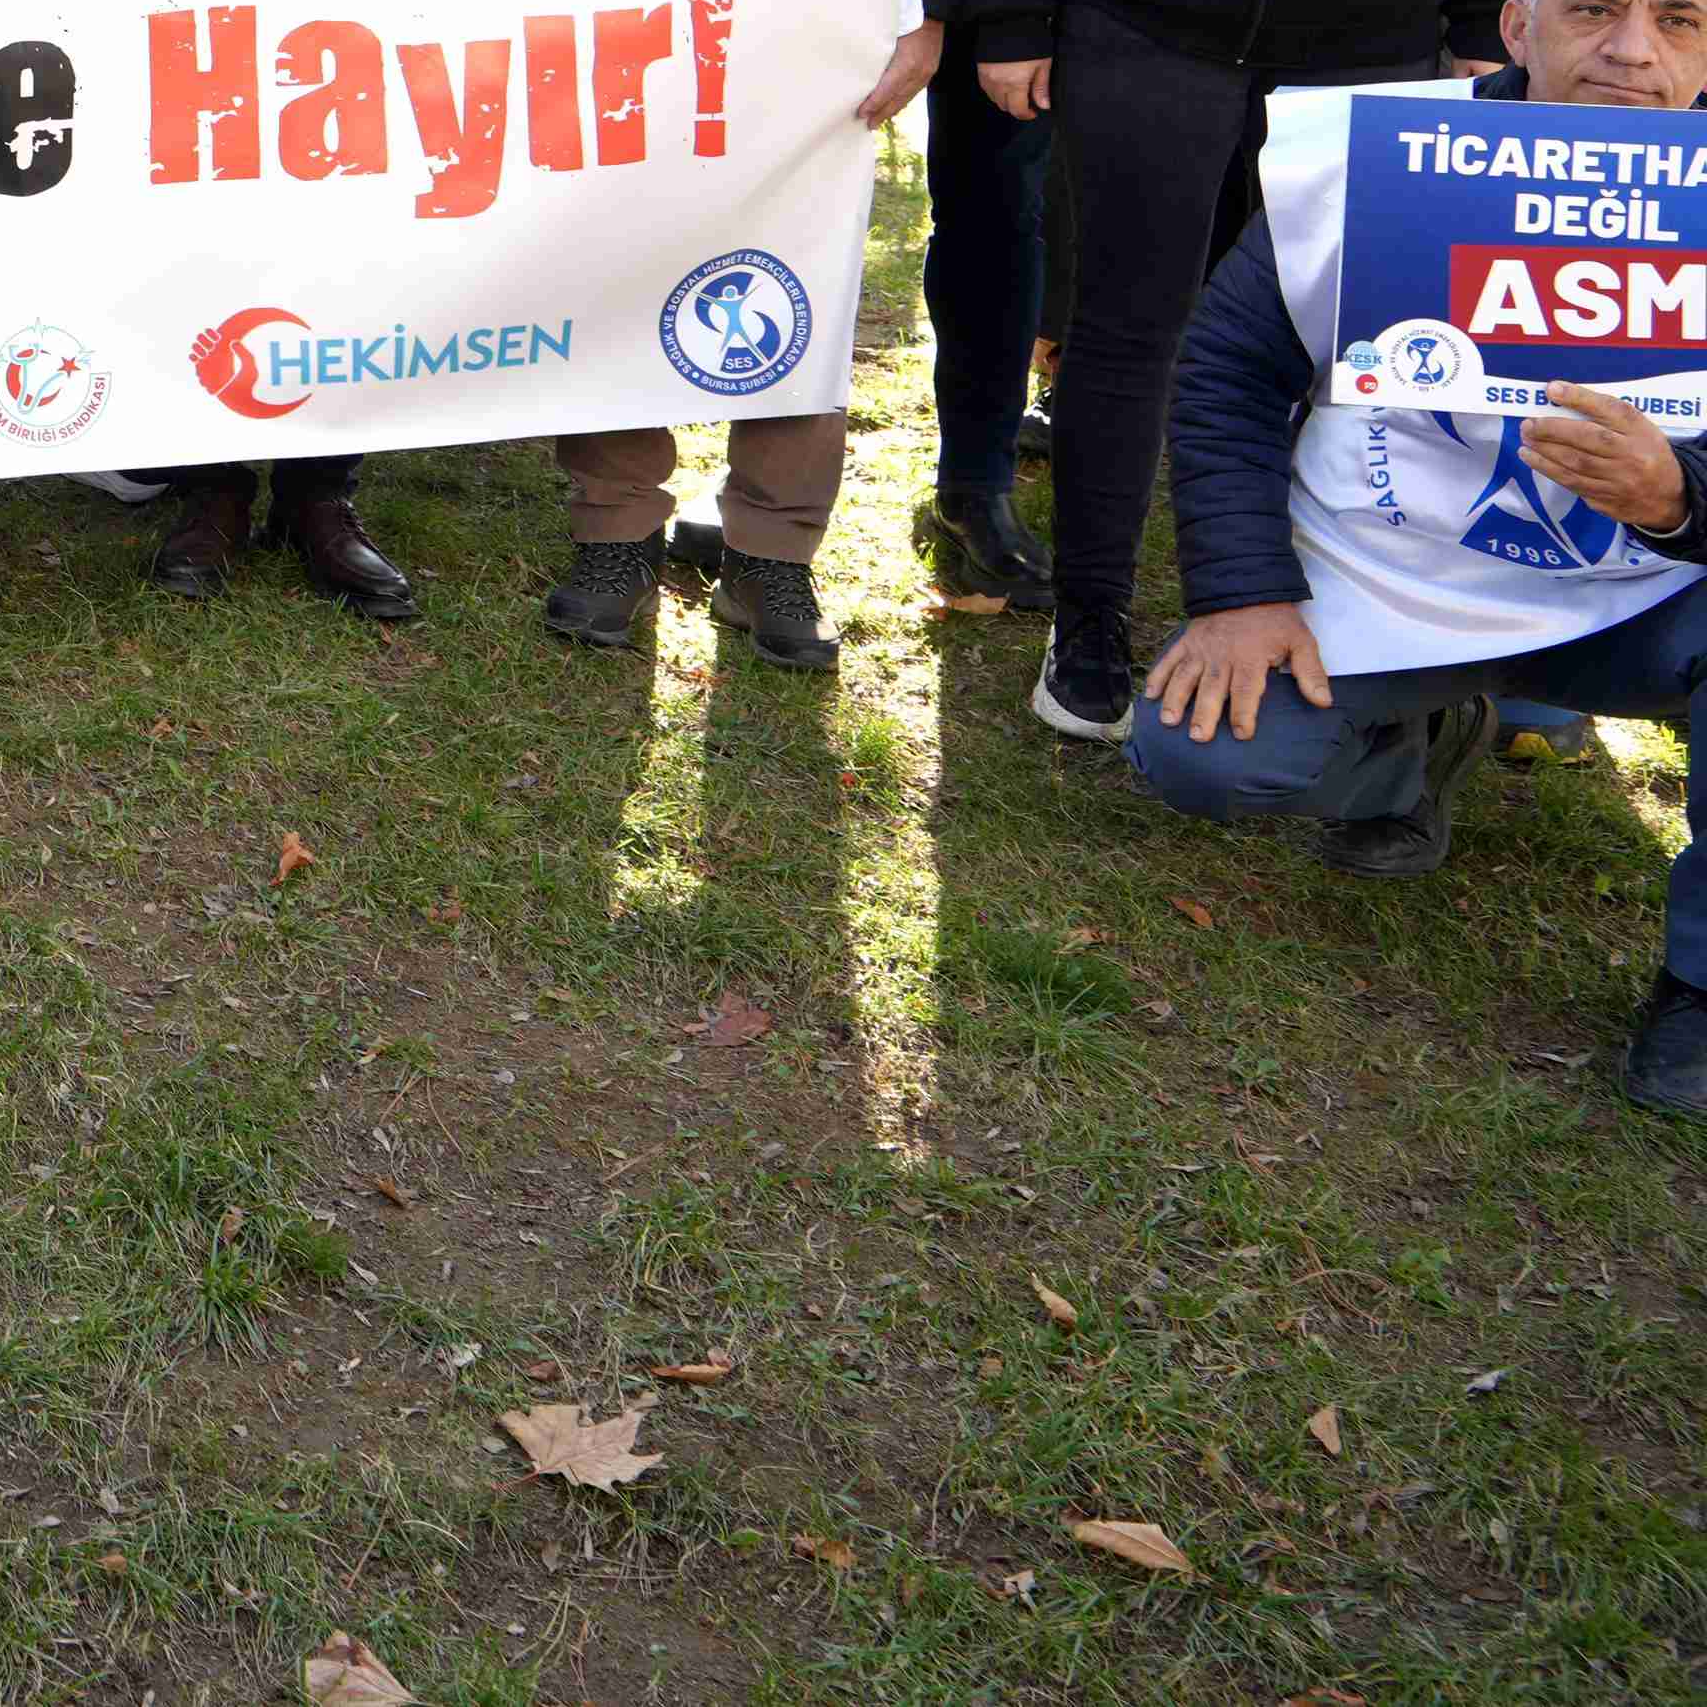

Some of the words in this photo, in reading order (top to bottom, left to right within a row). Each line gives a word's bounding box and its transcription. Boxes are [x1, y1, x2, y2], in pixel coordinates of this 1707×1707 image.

[1514, 189, 1679, 242] DEĞİL
[1468, 259, 1707, 340] ASM
[269, 319, 573, 387] HEKİMSEN
[725, 357, 753, 370] SES
[8, 422, 57, 442] BİRLİĞİ
[58, 377, 106, 438] SENDİKASI
[700, 375, 737, 391] BURSA
[1486, 387, 1528, 405] SES
[1366, 425, 1407, 527] SAĞLIK
[1486, 538, 1562, 566] 1996
